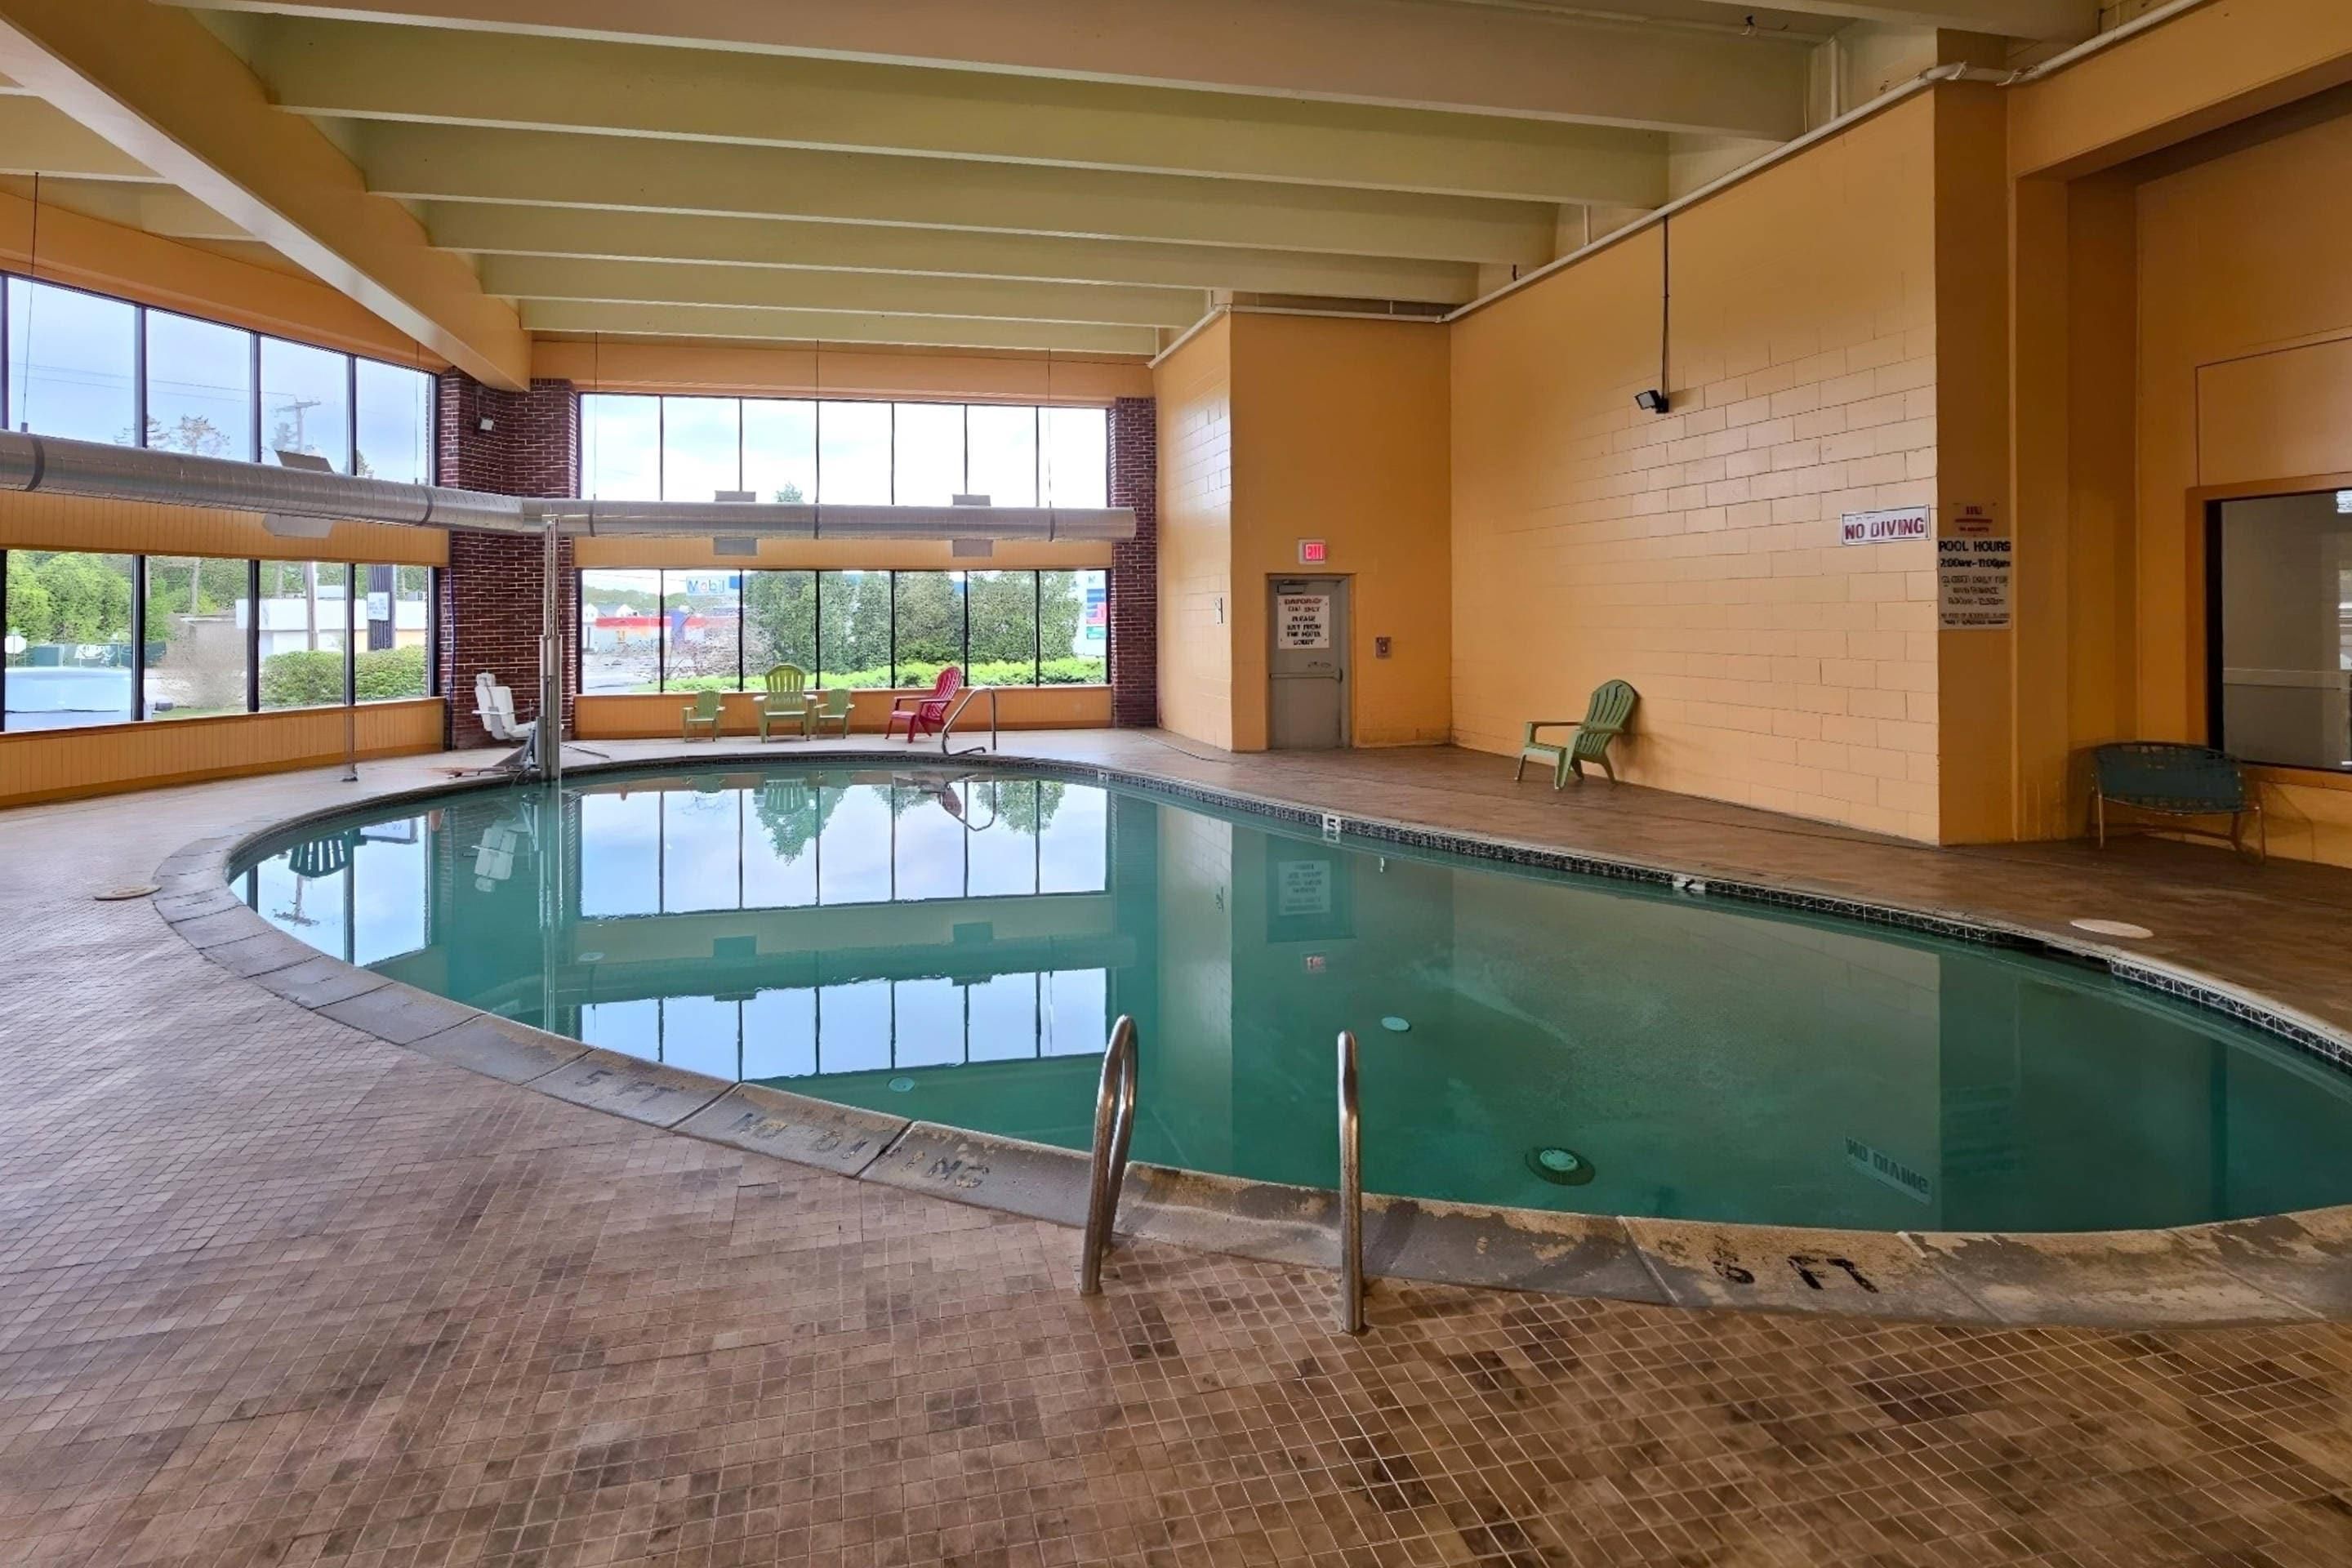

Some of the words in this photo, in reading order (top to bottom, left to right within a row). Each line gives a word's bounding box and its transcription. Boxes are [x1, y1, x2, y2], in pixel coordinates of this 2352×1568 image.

[1845, 523, 1864, 540] NO
[1870, 518, 1924, 537] DIVING
[1939, 541, 1969, 552] POOL
[1974, 541, 2011, 552] HOURS
[575, 1070, 612, 1087] 5
[1786, 1254, 1879, 1294] FT
